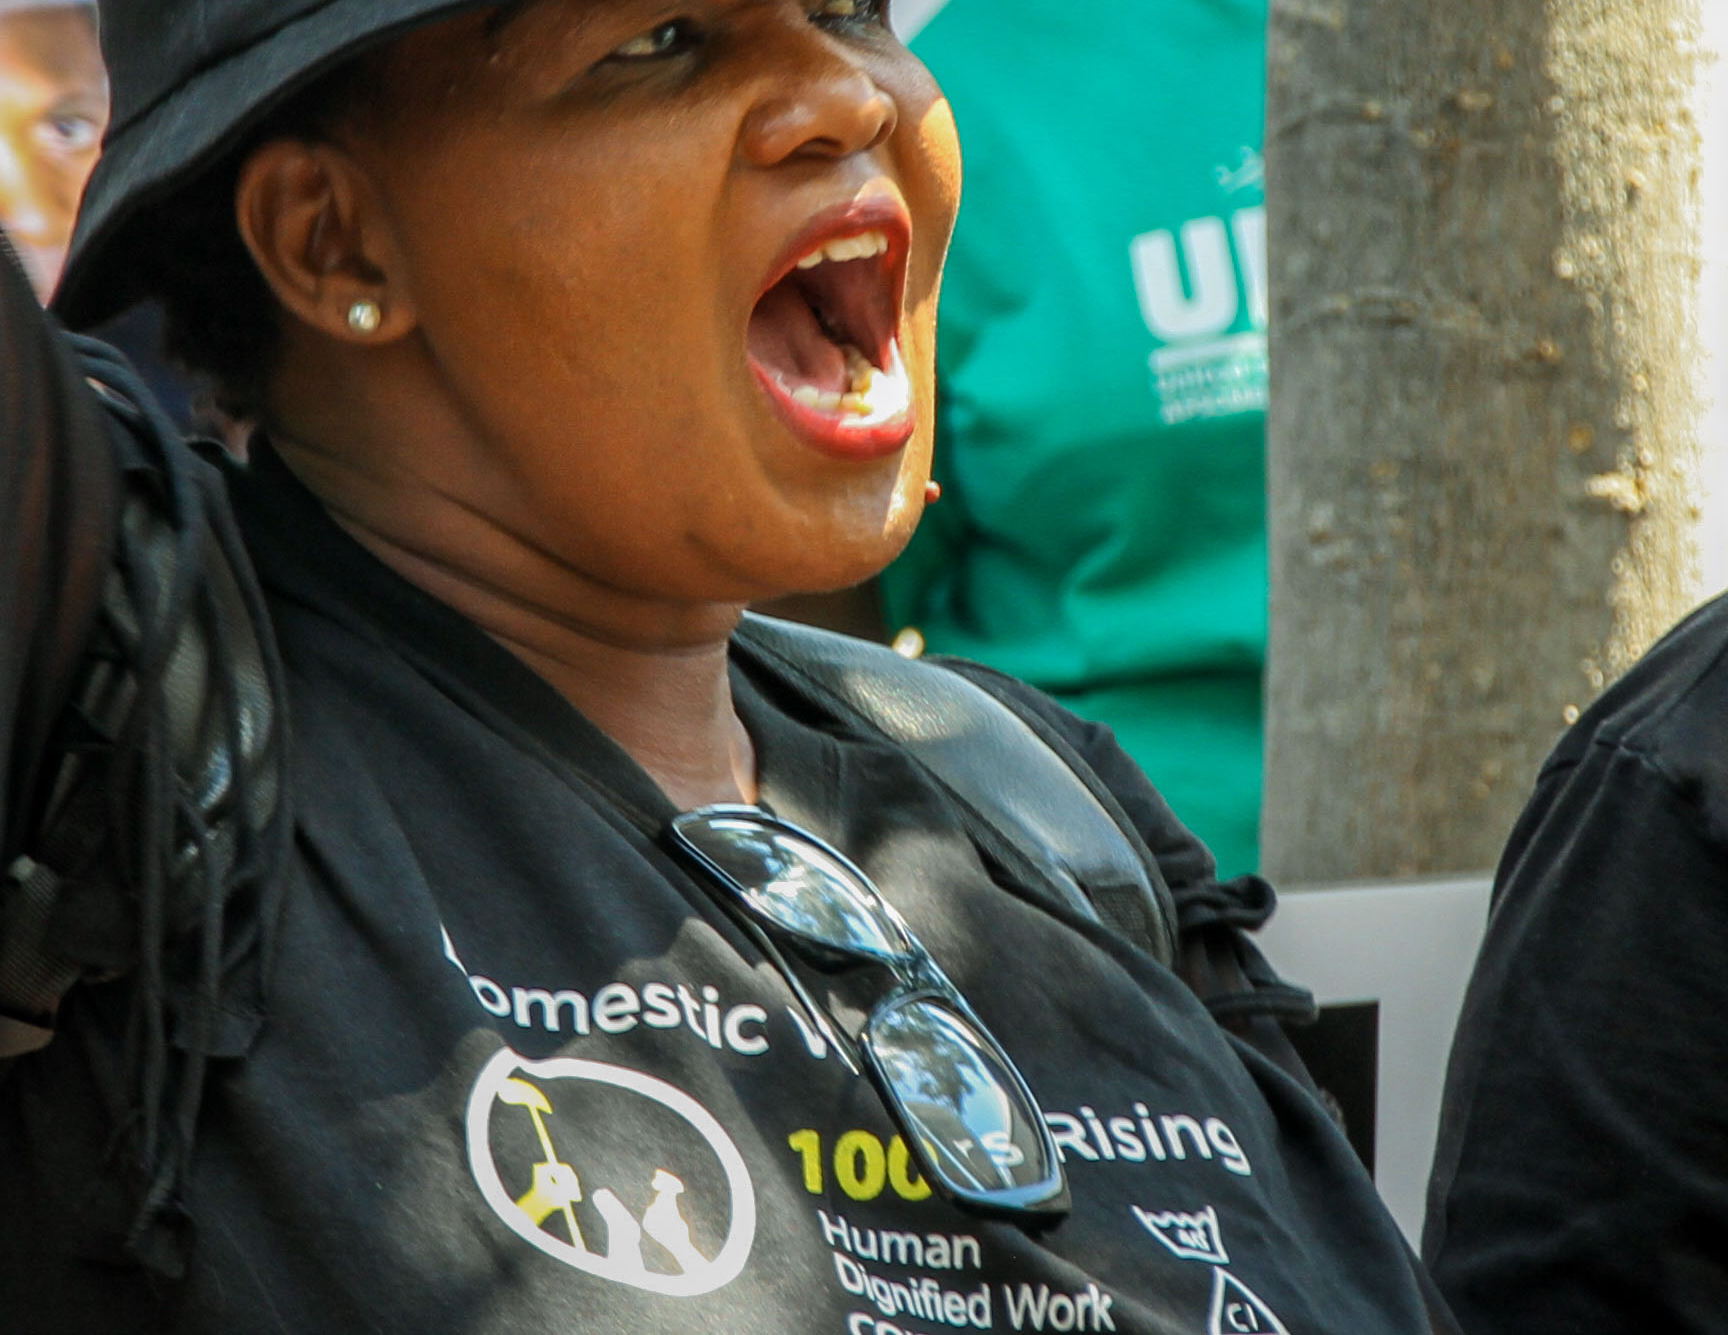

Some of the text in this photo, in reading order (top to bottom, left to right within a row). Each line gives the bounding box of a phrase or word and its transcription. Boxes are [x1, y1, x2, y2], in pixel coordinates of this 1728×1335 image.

[440, 944, 770, 1056] omestic
[1046, 1101, 1253, 1177] Rising
[817, 1209, 983, 1271] Human
[832, 1251, 1117, 1333] Dignified Work
